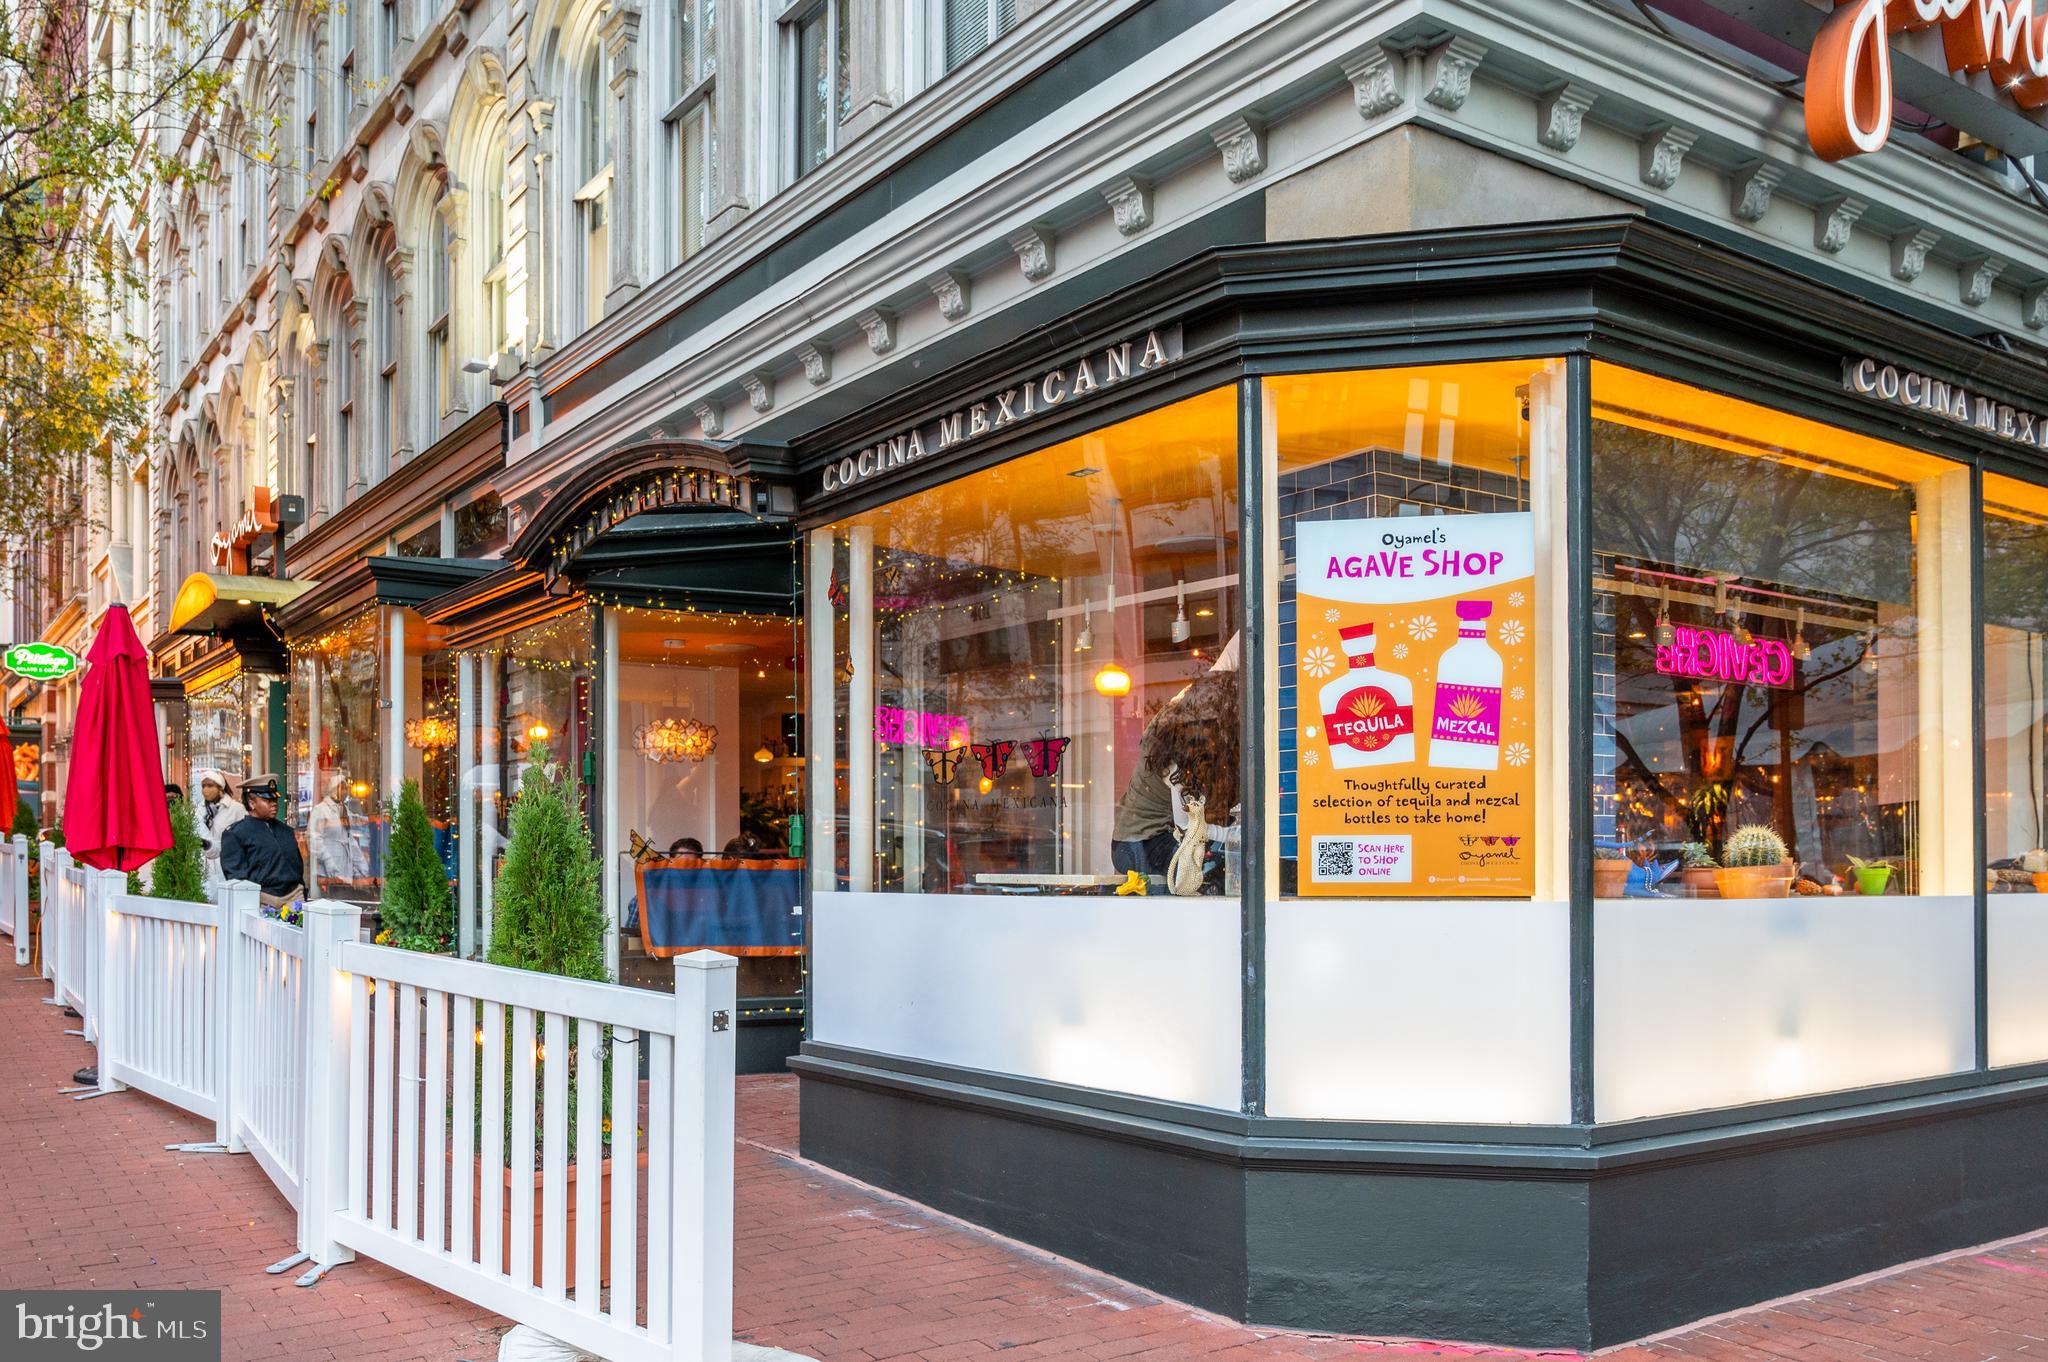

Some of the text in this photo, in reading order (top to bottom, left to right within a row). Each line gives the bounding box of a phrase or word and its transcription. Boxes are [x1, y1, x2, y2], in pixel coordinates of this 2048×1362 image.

[1852, 358, 1968, 422] COCINA
[822, 331, 1168, 491] COCINA MEXICANA
[210, 486, 263, 575] Oyamel
[1381, 528, 1446, 549] Oyamel's
[1326, 549, 1504, 579] AGAVE SHOP
[1333, 713, 1404, 736] TEQUILA
[1436, 716, 1495, 736] MEZCAL
[1344, 775, 1486, 794] Thoughtfully curated
[1313, 792, 1520, 810] selection of tequila and mezcal
[1344, 809, 1487, 824] bottles to take home!
[1358, 843, 1405, 853] SCAN HERE
[1358, 855, 1399, 865] TO SHOP
[1358, 868, 1391, 876] ONLINE
